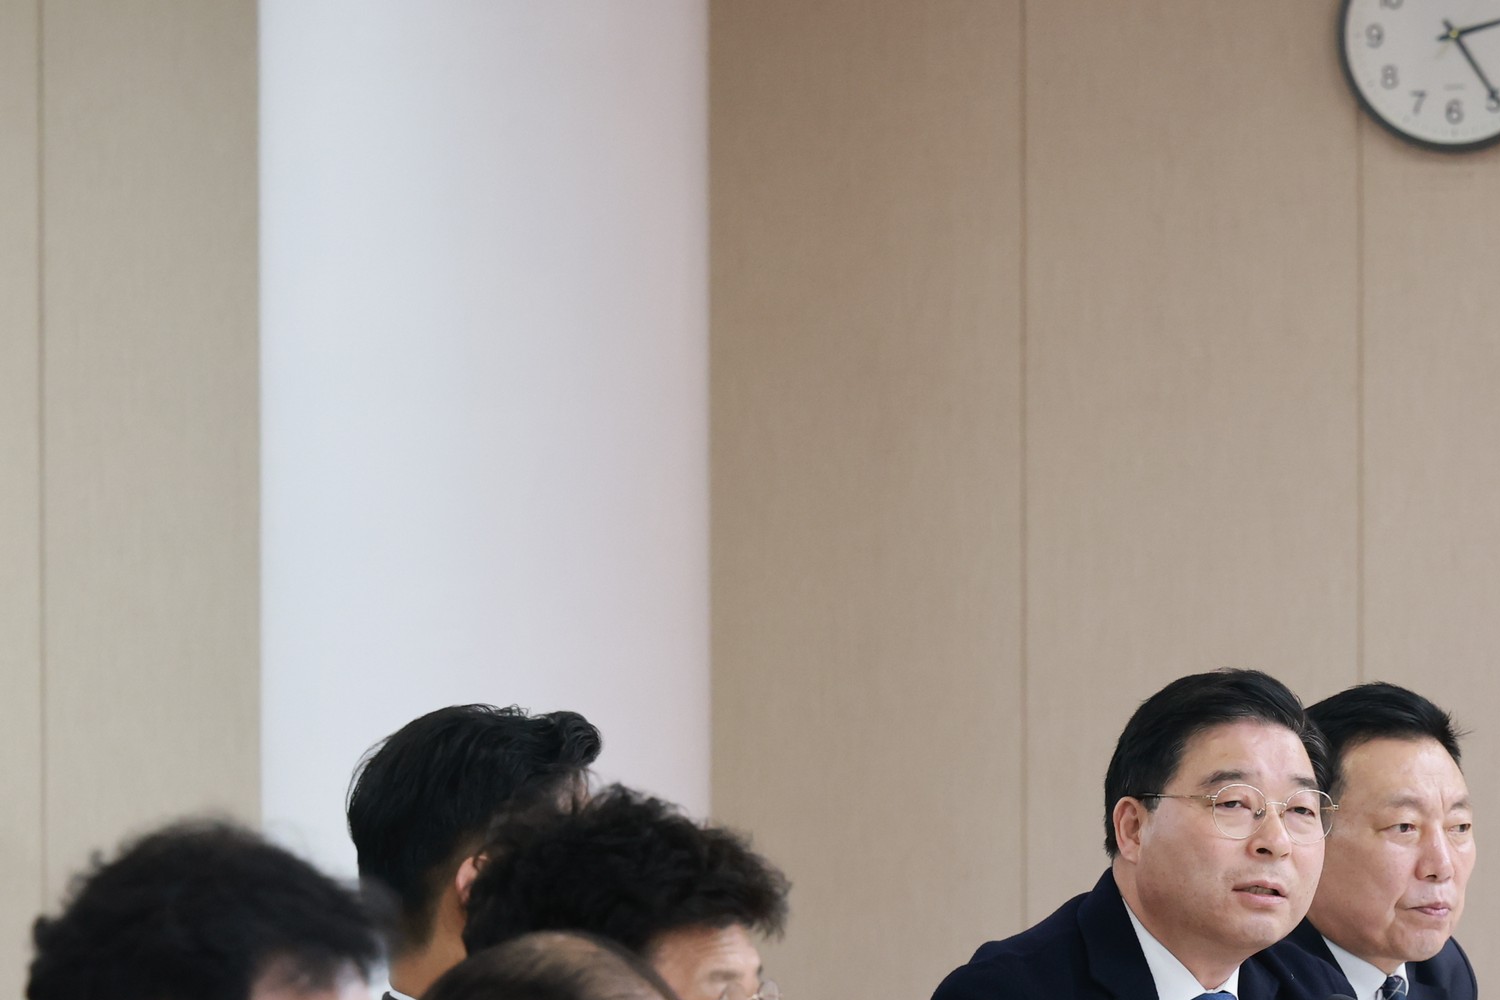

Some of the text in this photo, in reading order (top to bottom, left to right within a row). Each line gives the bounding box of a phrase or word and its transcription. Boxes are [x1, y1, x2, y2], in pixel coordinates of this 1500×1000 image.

[1365, 22, 1384, 48] 9
[1380, 64, 1399, 90] 8
[1410, 90, 1428, 115] 7
[1445, 99, 1464, 124] 6
